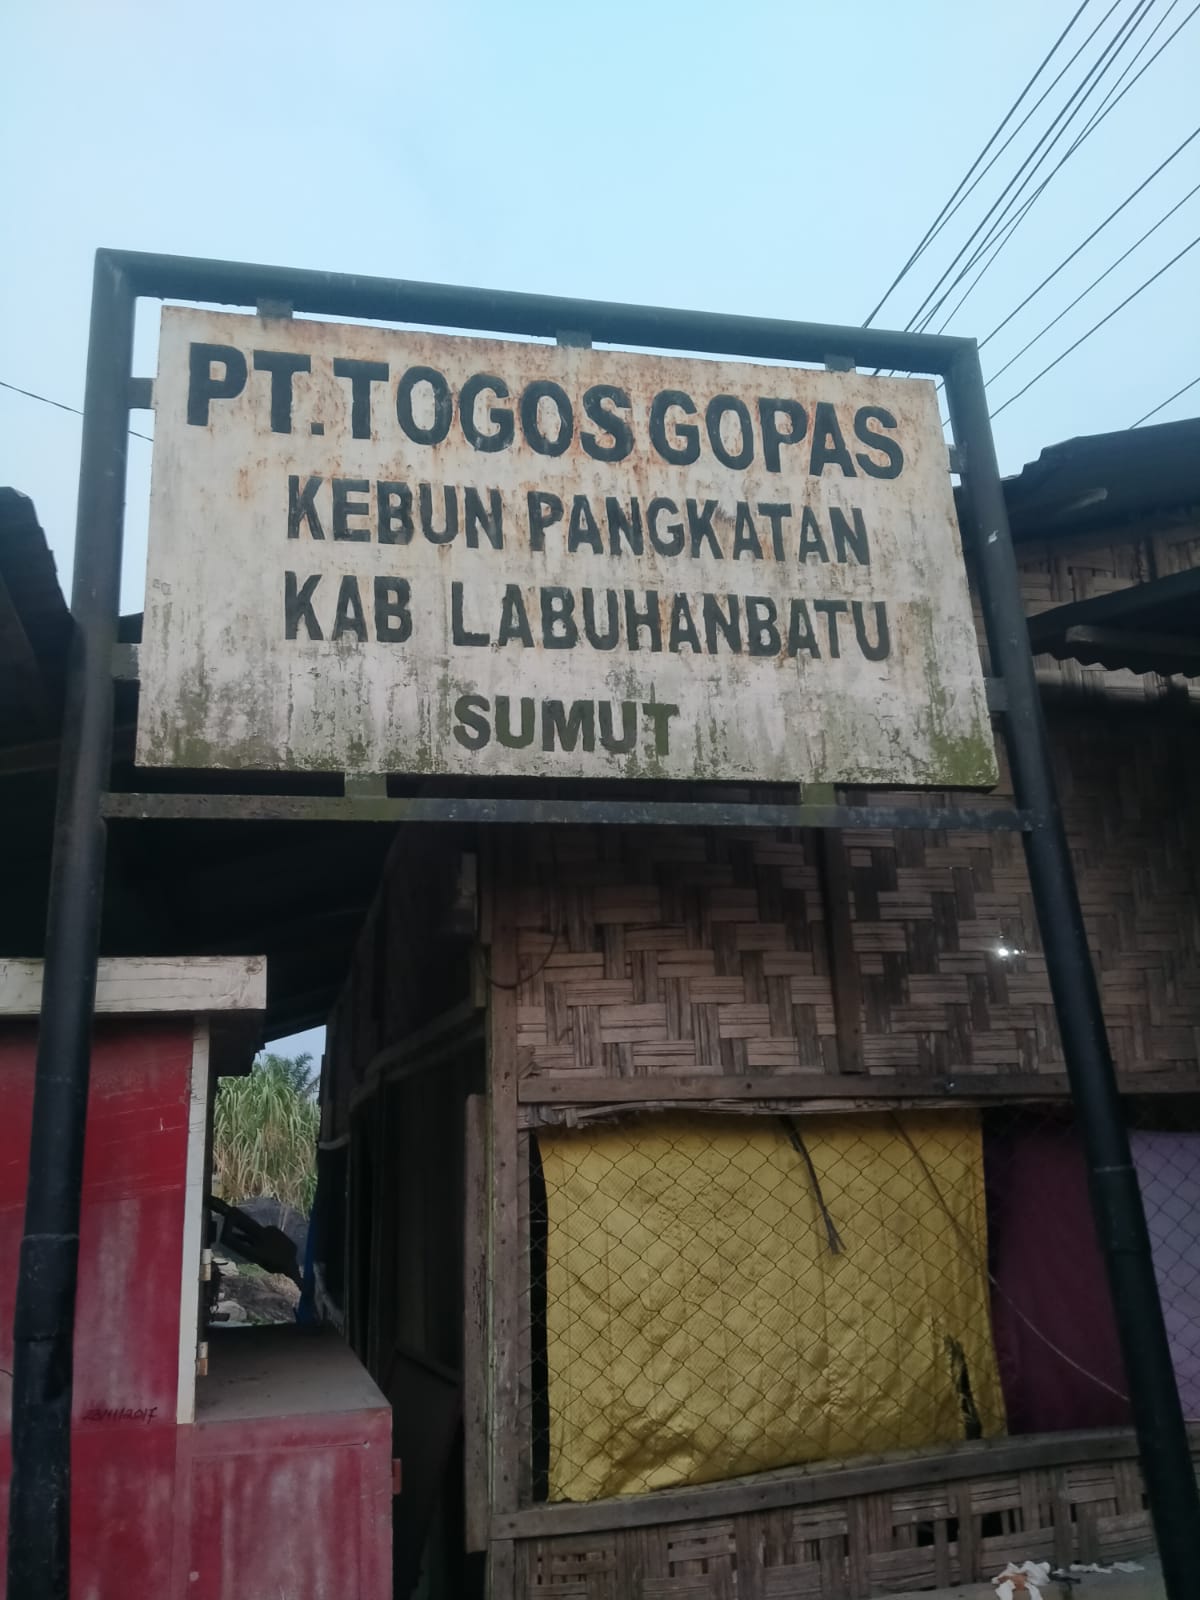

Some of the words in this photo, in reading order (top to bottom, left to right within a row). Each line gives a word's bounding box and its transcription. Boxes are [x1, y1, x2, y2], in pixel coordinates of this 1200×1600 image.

[287, 475, 503, 549] KEBUN
[528, 491, 870, 565] PANGKATAN
[284, 571, 413, 643] KAB
[451, 581, 890, 661] LABUHANBATU
[453, 695, 680, 755] SUMUT
